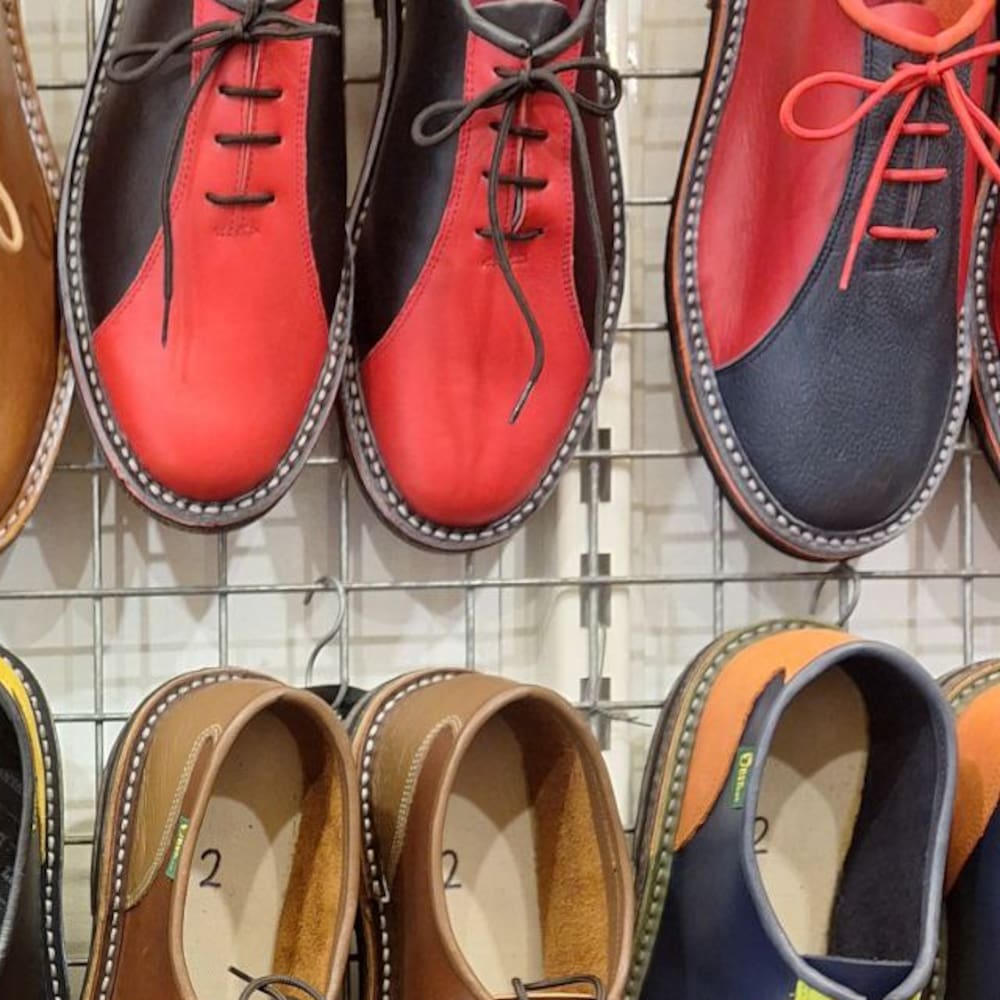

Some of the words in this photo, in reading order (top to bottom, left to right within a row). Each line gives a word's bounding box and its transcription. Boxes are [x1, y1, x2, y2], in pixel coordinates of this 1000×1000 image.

[754, 816, 769, 853] 2
[200, 848, 222, 887] 2
[442, 849, 462, 888] 2
